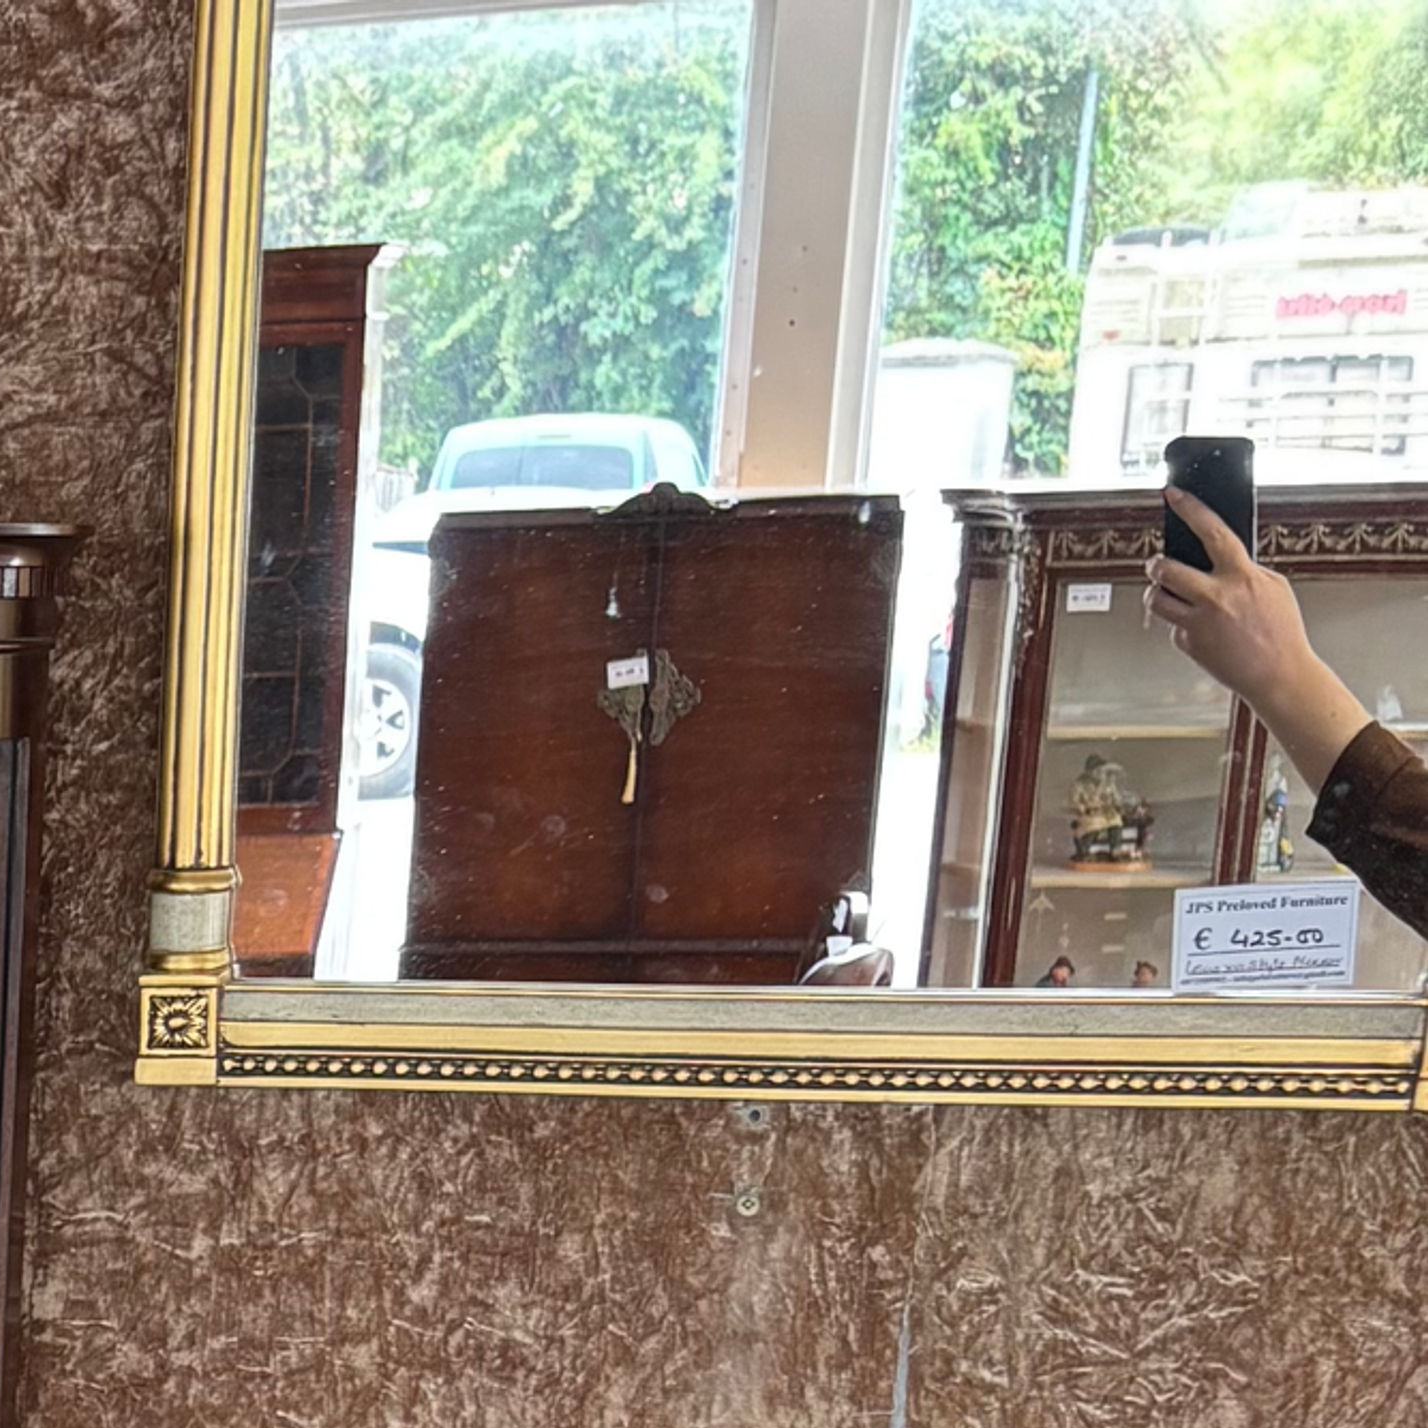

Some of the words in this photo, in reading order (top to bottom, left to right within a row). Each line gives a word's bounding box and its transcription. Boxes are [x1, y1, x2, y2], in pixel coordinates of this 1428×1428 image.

[1186, 901, 1213, 914] JPS
[1218, 897, 1277, 912] Preloved
[1281, 895, 1348, 908] Furniture
[1194, 927, 1213, 950] €
